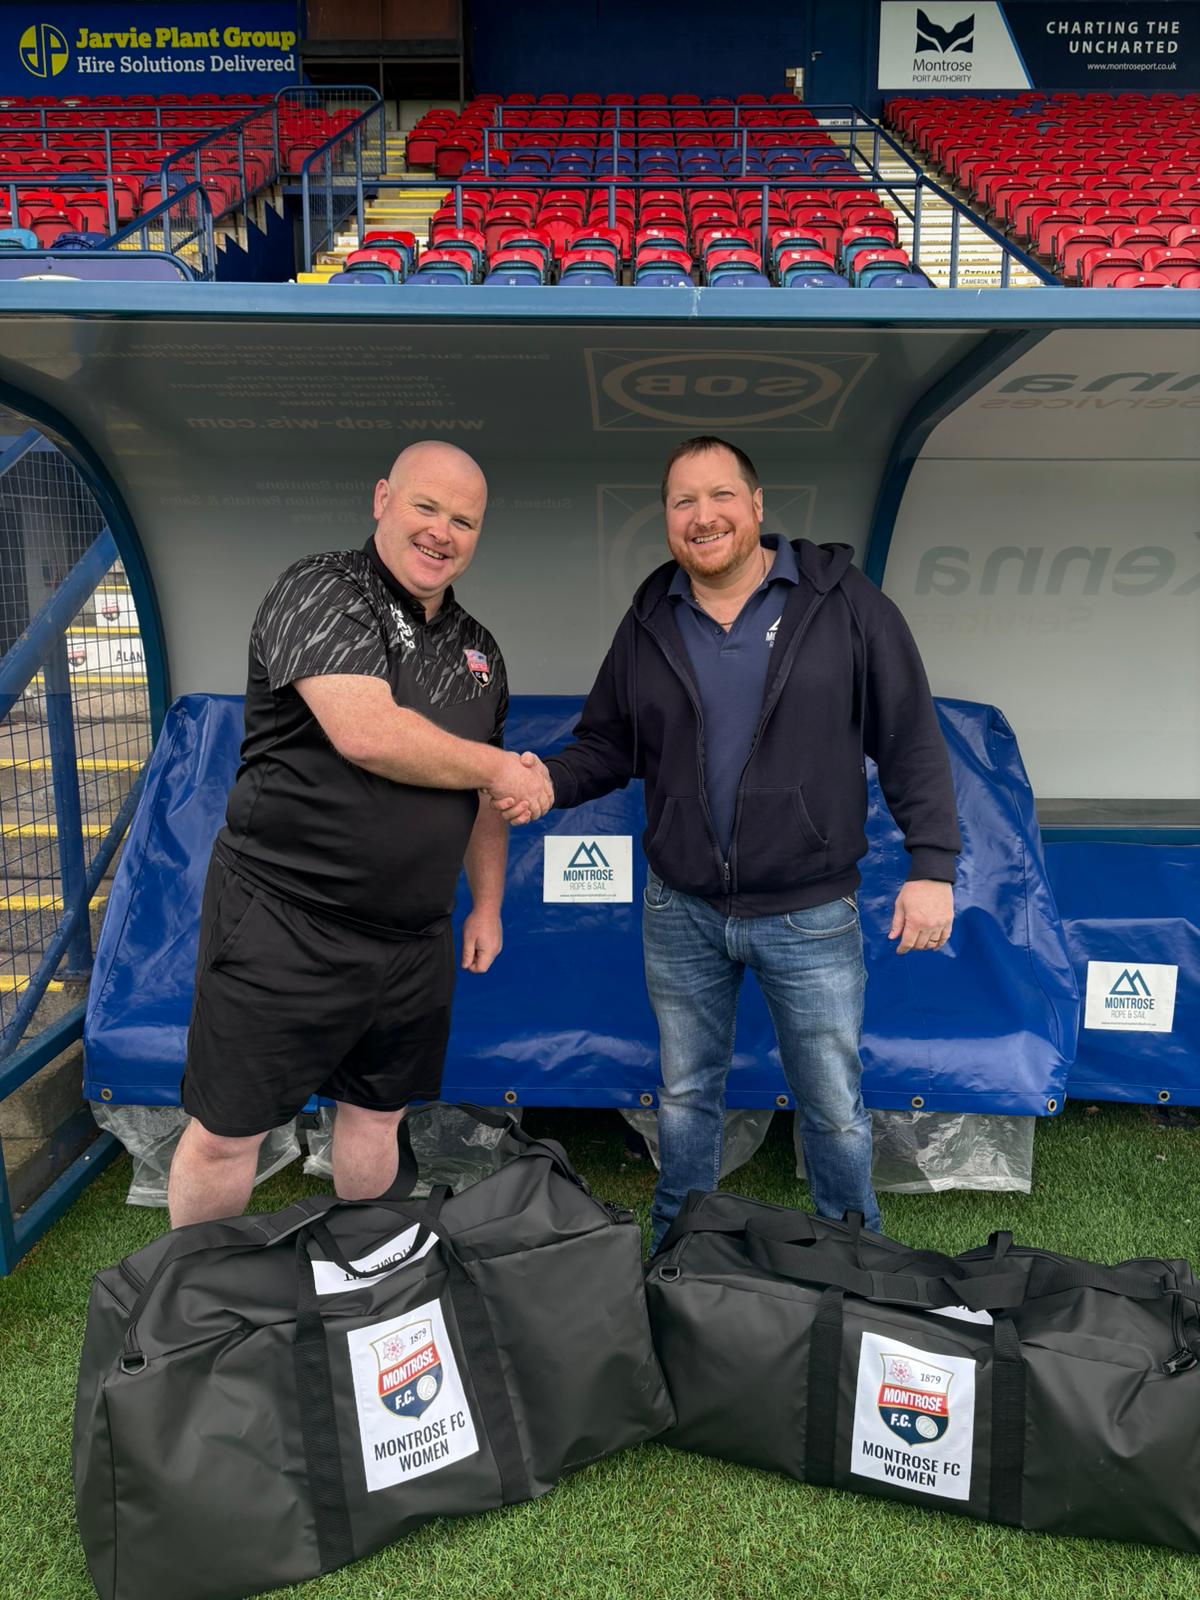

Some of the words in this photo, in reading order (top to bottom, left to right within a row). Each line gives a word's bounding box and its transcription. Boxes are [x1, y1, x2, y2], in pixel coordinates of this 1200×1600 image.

[1046, 21, 1139, 34] CHARTING
[1147, 21, 1180, 34] THE
[76, 28, 151, 48] Jarvie
[155, 28, 219, 47] Plant
[223, 27, 296, 50] Group
[1069, 41, 1178, 54] UNCHARTED
[77, 56, 115, 73] Hire
[120, 56, 205, 73] Solutions
[210, 54, 296, 72] Delivered
[912, 58, 973, 72] Montrose
[1087, 63, 1177, 71] www.montroseport.co.uk
[912, 74, 931, 83] PORT
[932, 74, 971, 83] AUTHORITY
[563, 870, 614, 881] MONTROSE
[570, 882, 586, 890] ROPE
[593, 882, 607, 890] SAIL
[1104, 997, 1155, 1010] MONTROSE
[1111, 1010, 1126, 1018] ROPE
[1133, 1010, 1146, 1018] SAIL
[409, 1328, 427, 1345] 1879
[383, 1347, 434, 1390] MONTROSE
[920, 1373, 941, 1384] 1879
[395, 1390, 415, 1409] F.C.
[884, 1388, 943, 1412] MONTROSE
[890, 1413, 911, 1428] F.C.
[374, 1418, 447, 1461] MONTROSE
[451, 1410, 466, 1432] FC
[399, 1439, 449, 1472] WOMEN
[862, 1440, 939, 1473] MONTROSE
[943, 1463, 960, 1476] FC
[884, 1463, 936, 1487] WOMEN
